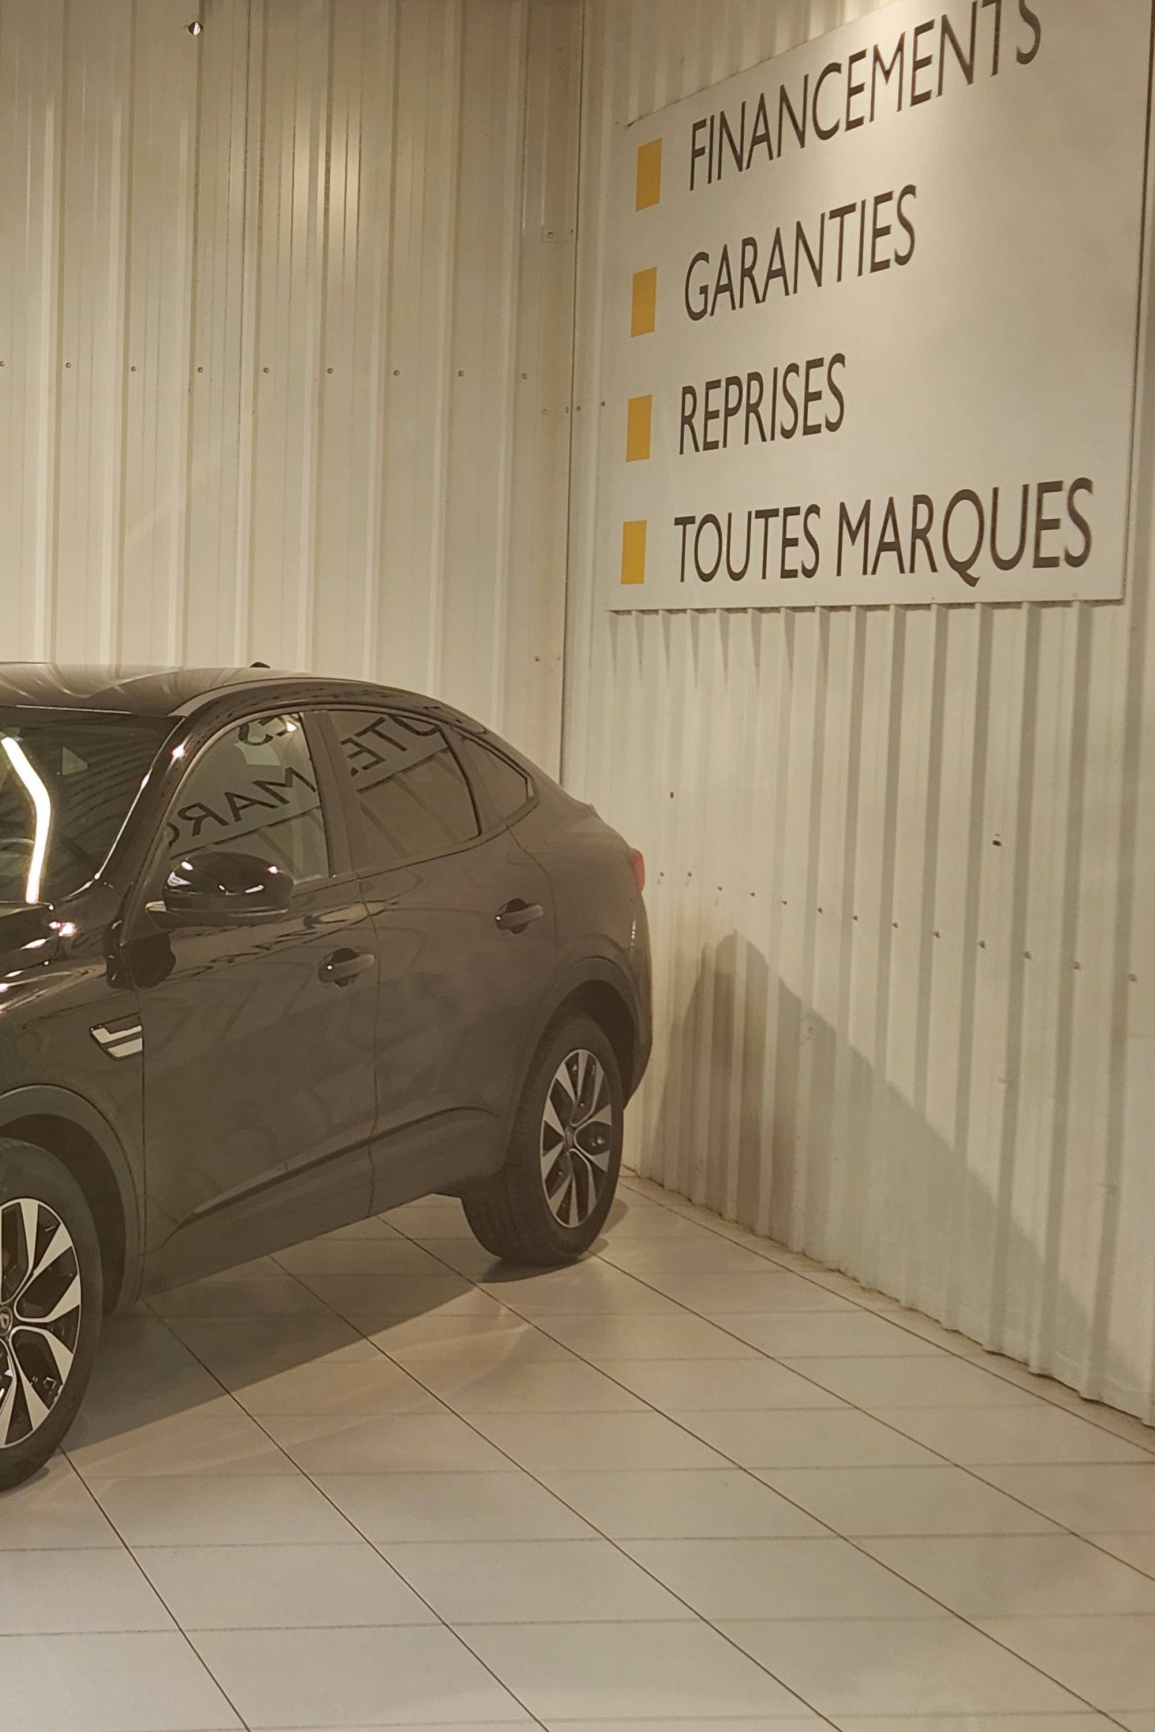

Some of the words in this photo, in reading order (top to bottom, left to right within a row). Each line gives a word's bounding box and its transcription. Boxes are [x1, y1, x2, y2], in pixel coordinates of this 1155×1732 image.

[688, 0, 1042, 193] FINANCEMENTS
[683, 183, 918, 322] GARANTIES
[678, 352, 847, 456] REPRISES
[673, 503, 822, 584] TOUTES
[835, 476, 1094, 589] MARQUES
